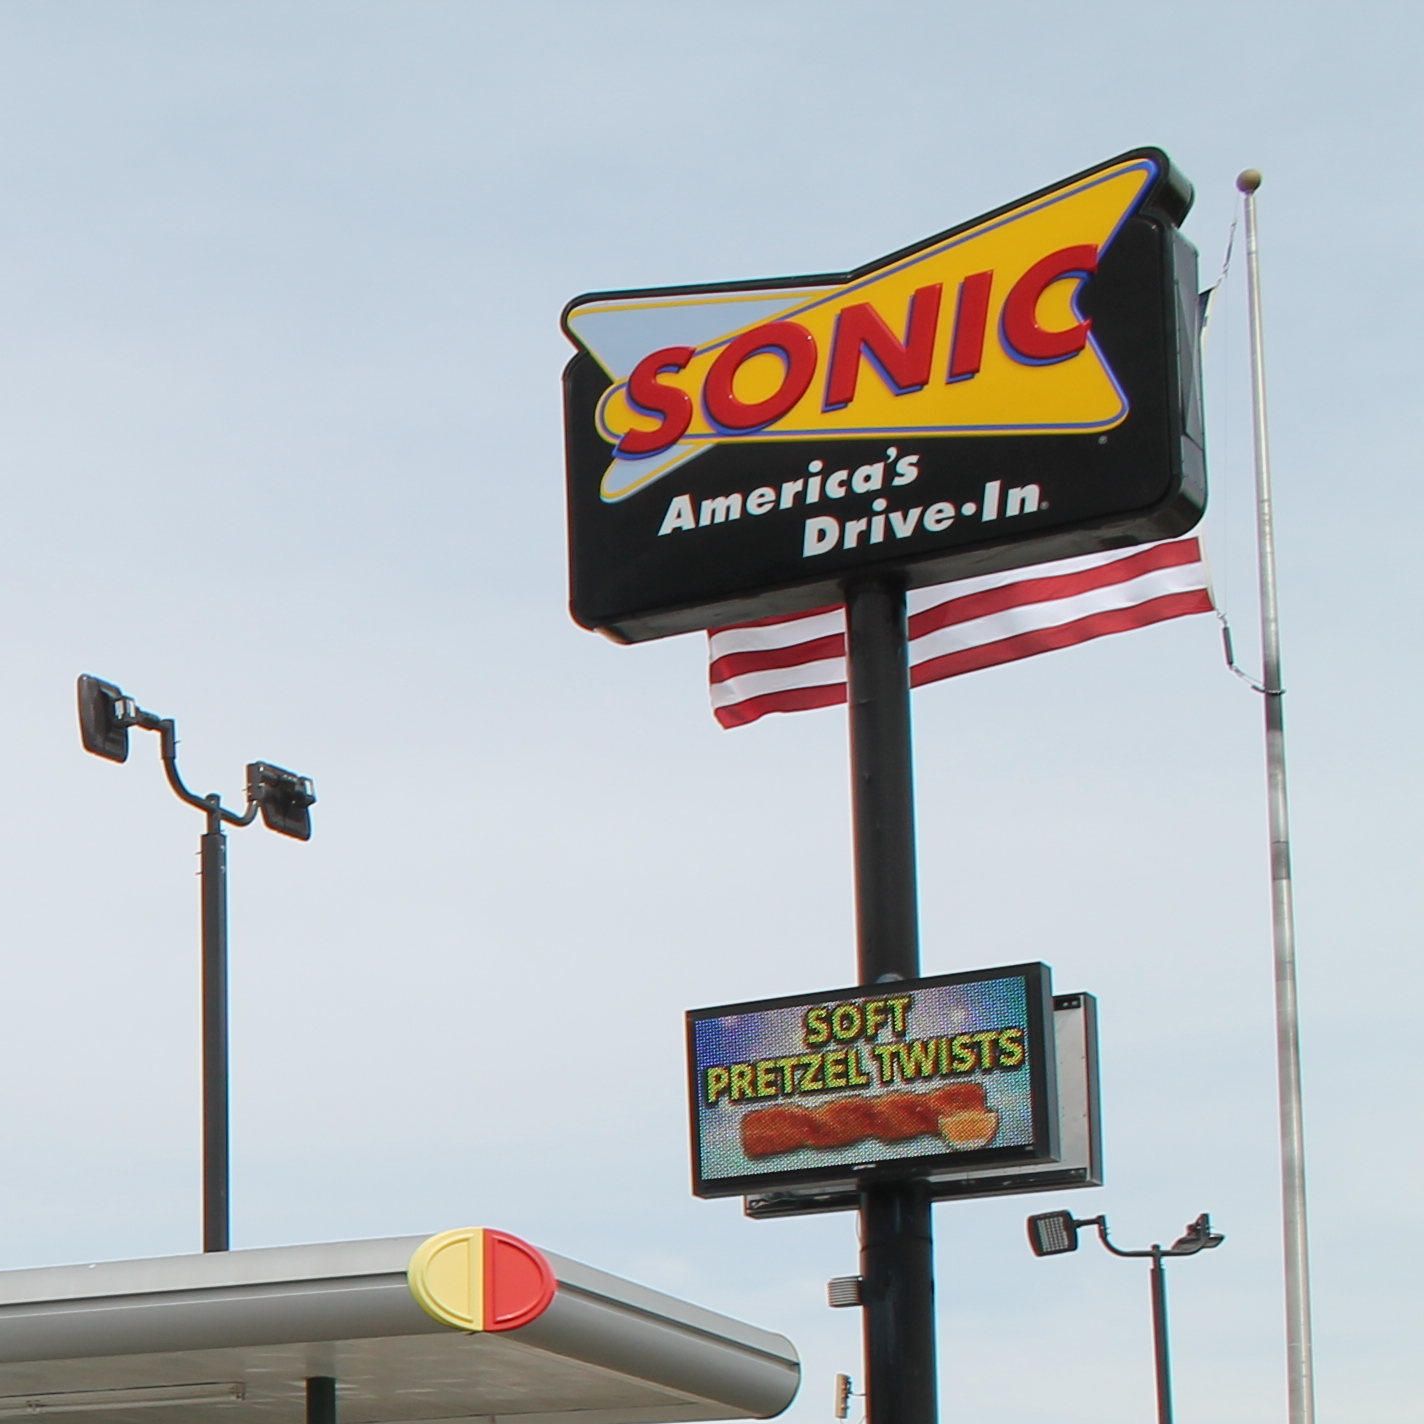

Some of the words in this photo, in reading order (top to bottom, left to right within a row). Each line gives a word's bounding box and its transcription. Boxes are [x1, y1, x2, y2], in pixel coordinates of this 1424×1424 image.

[614, 244, 1099, 460] SONIC
[657, 446, 920, 537] America's
[805, 997, 911, 1046] SOFT
[705, 1048, 870, 1105] PRETZEL
[872, 1028, 1026, 1085] TWISTS
